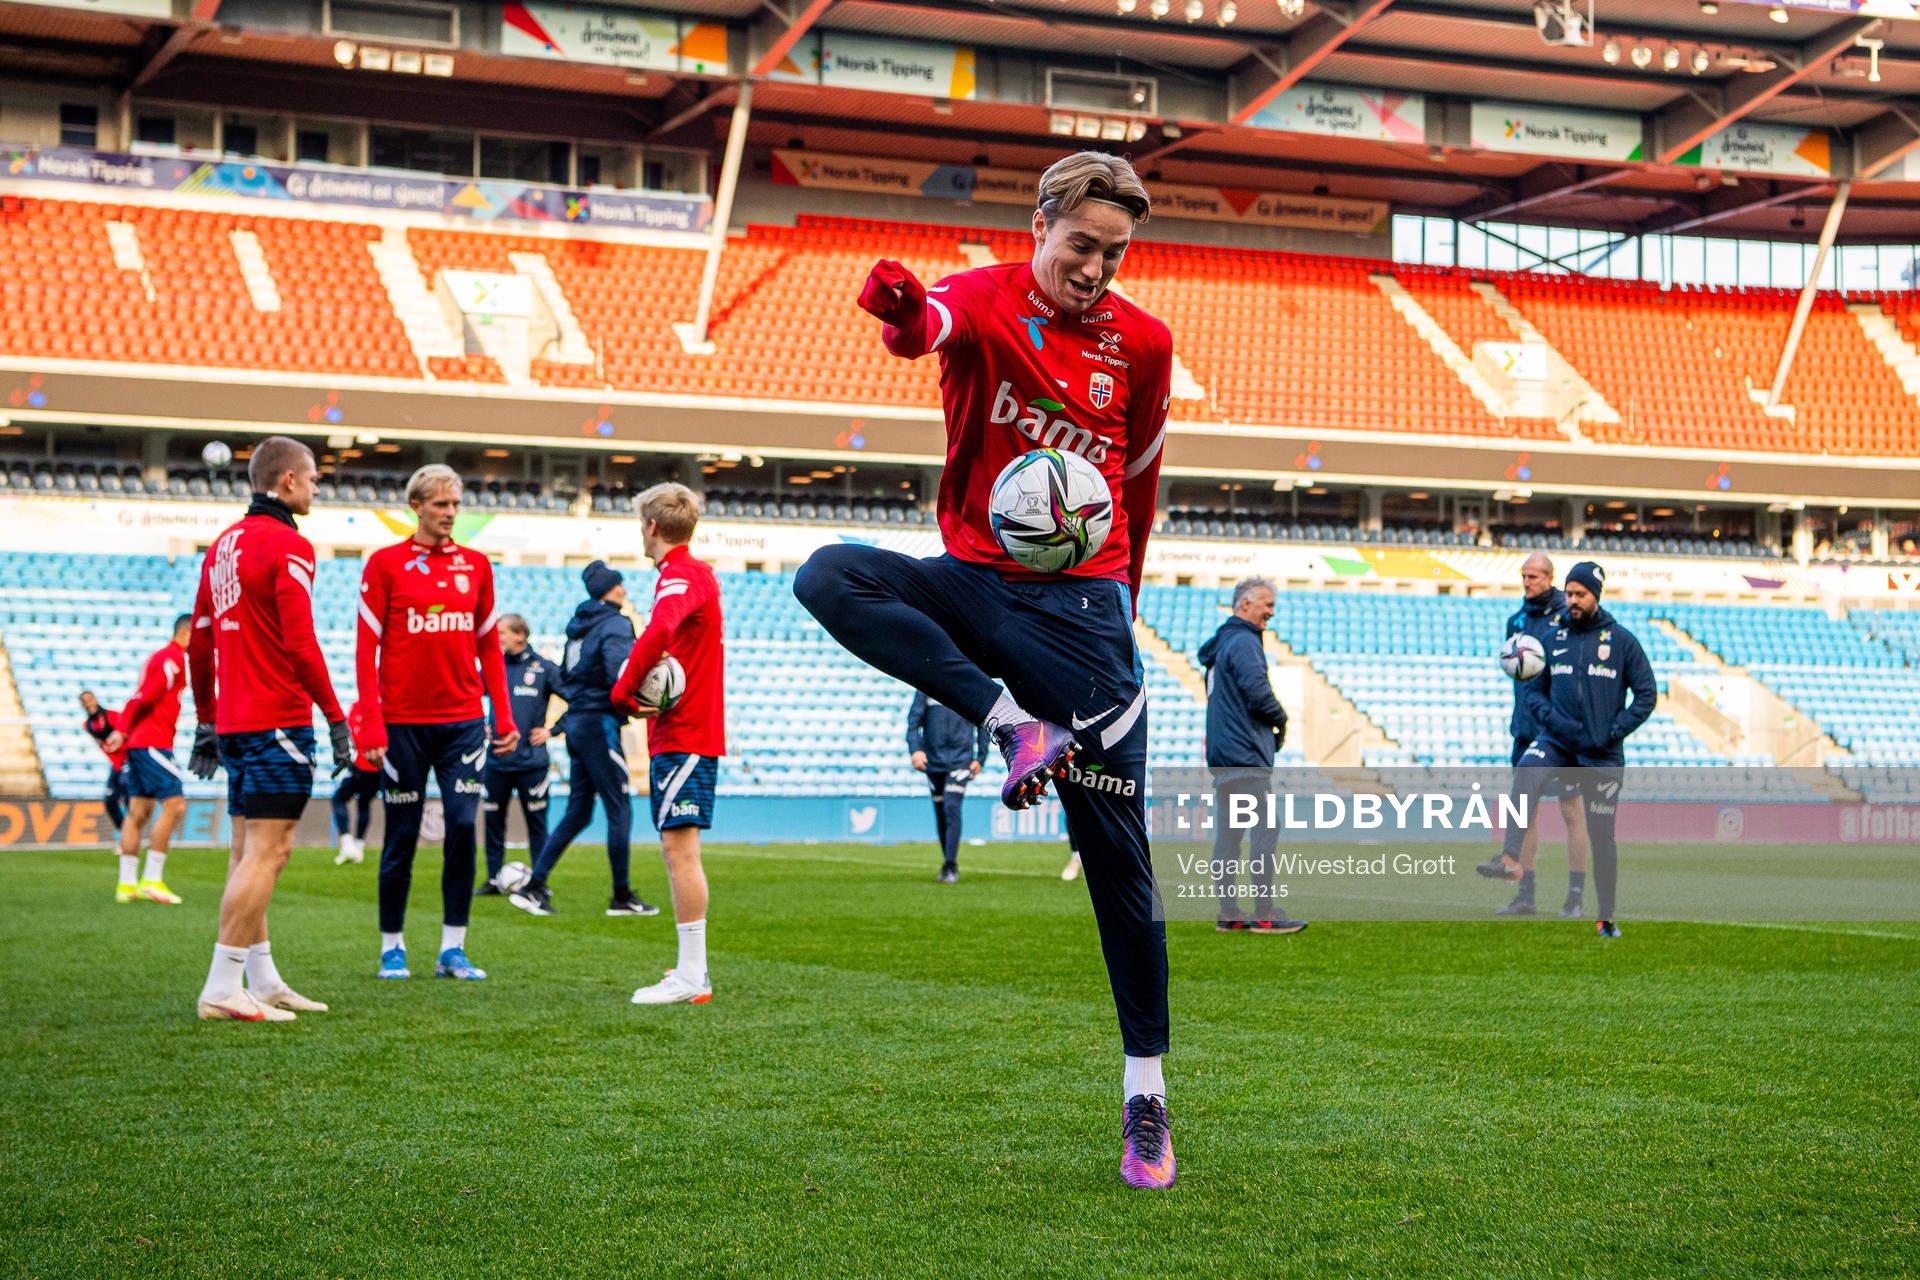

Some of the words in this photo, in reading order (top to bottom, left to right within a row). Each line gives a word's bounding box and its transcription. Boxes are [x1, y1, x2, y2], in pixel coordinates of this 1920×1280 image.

[836, 55, 879, 72] Norsk
[881, 57, 935, 81] Tipping
[1525, 124, 1559, 139] Norsk
[1562, 126, 1608, 148] Tipping
[1028, 290, 1055, 318] bama
[1081, 311, 1113, 324] bama
[1081, 349, 1103, 362] Norsk
[1103, 354, 1131, 369] Tipping
[990, 380, 1113, 464] bama
[1081, 598, 1089, 609] 3
[407, 607, 475, 634] bama
[1588, 664, 1617, 680] bama
[1068, 767, 1137, 797] bama
[384, 789, 419, 804] bama
